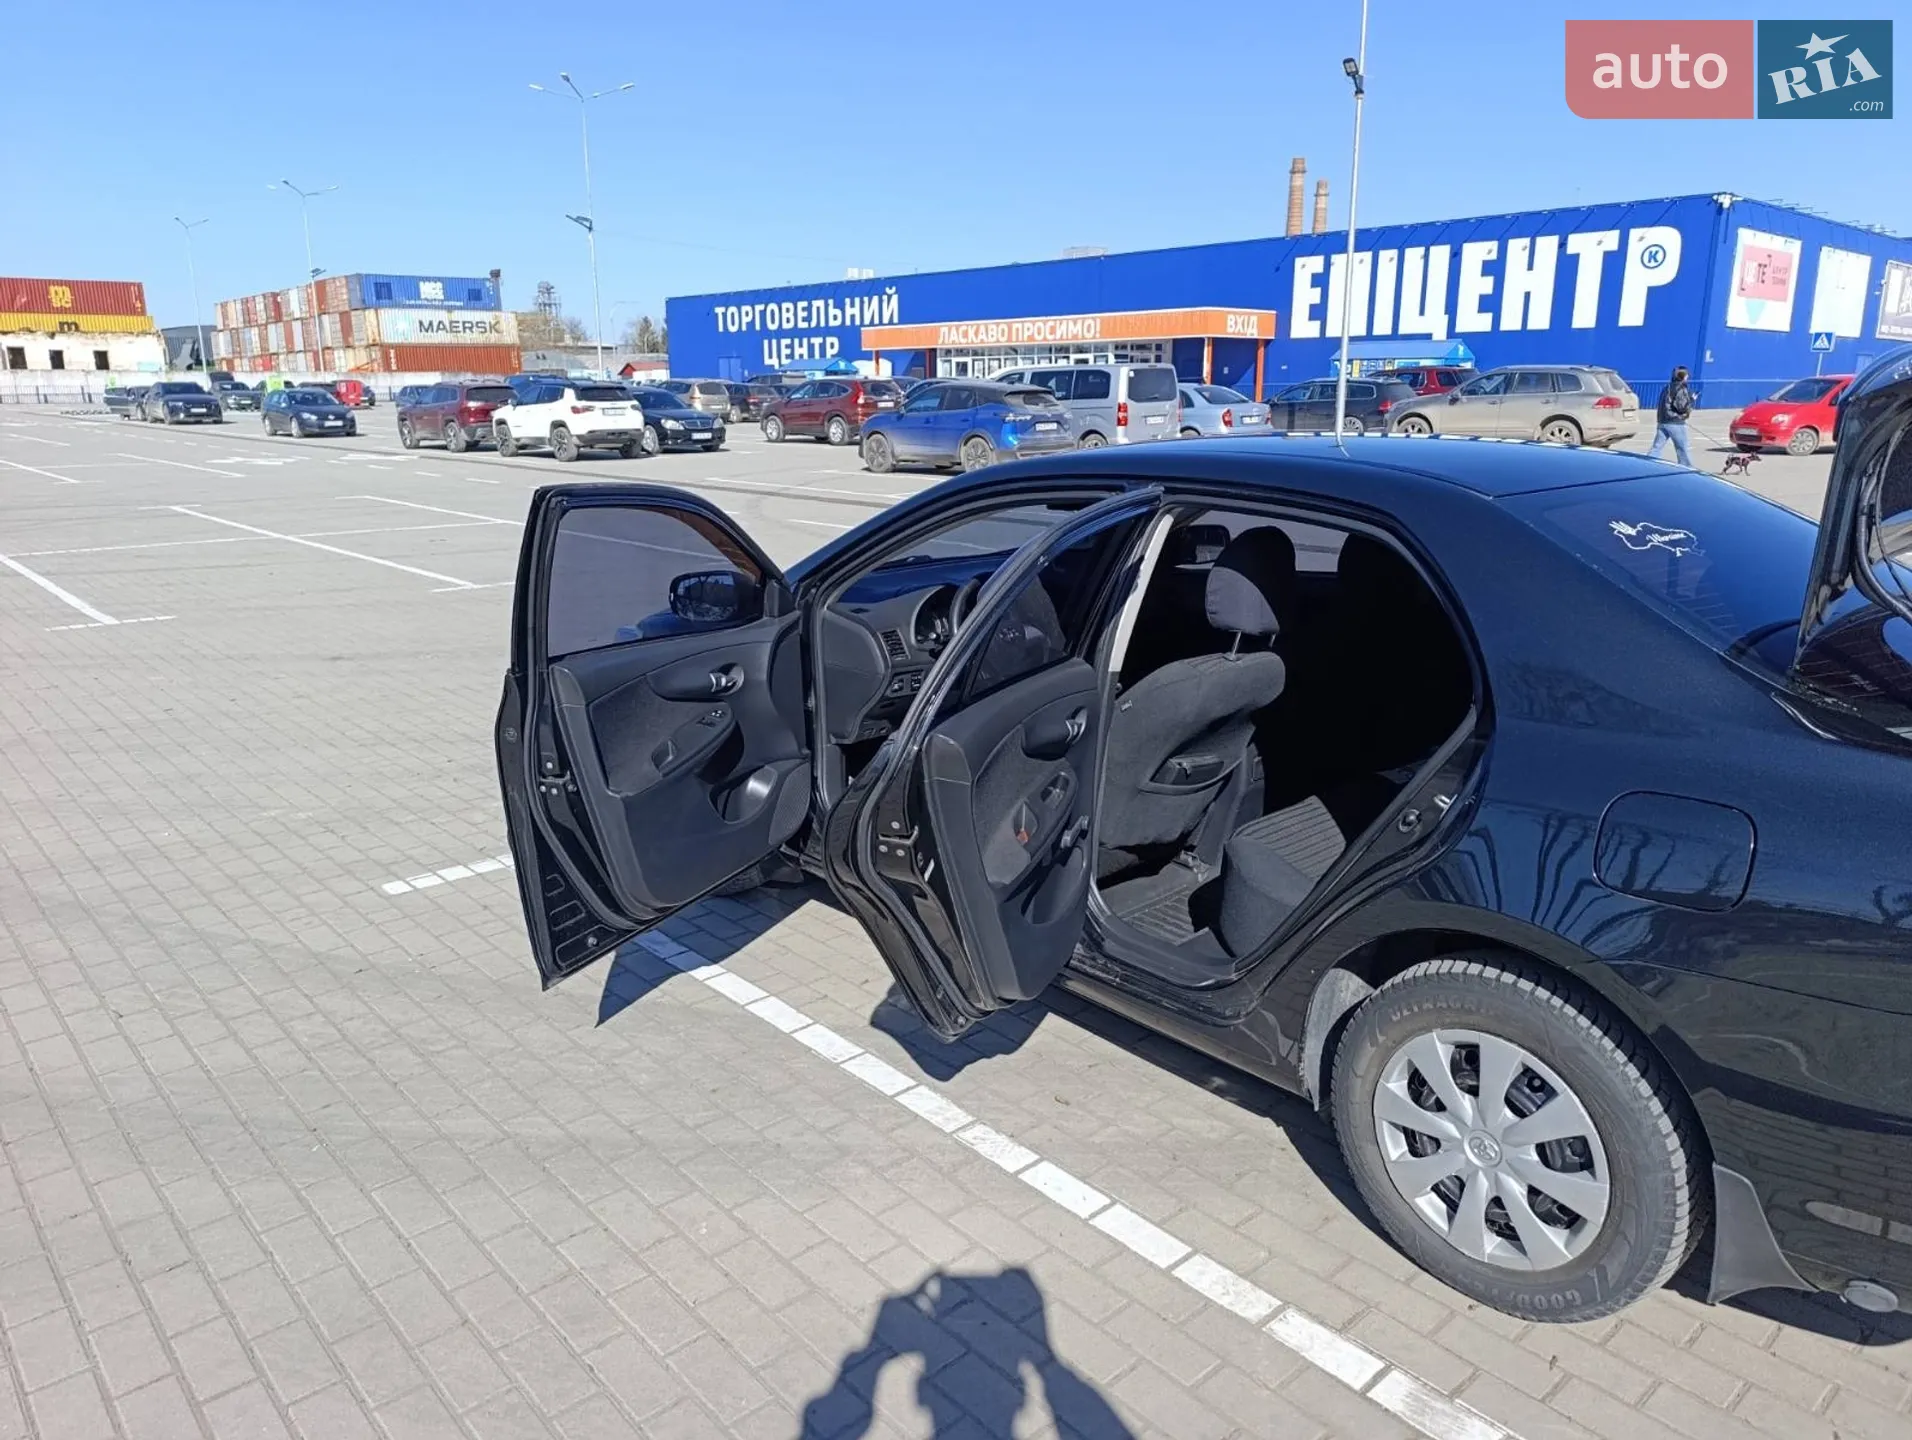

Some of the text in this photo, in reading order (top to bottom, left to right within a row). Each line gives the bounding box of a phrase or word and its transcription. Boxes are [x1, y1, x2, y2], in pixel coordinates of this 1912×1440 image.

[714, 286, 899, 333] ТОРГОВЕЛЬНИЙ
[418, 319, 504, 334] MAERSK
[937, 318, 1101, 345] ЛАСКАВО ПРОСИМО!
[1226, 314, 1259, 337] ВХІД
[763, 336, 840, 370] ЦЕНТР
